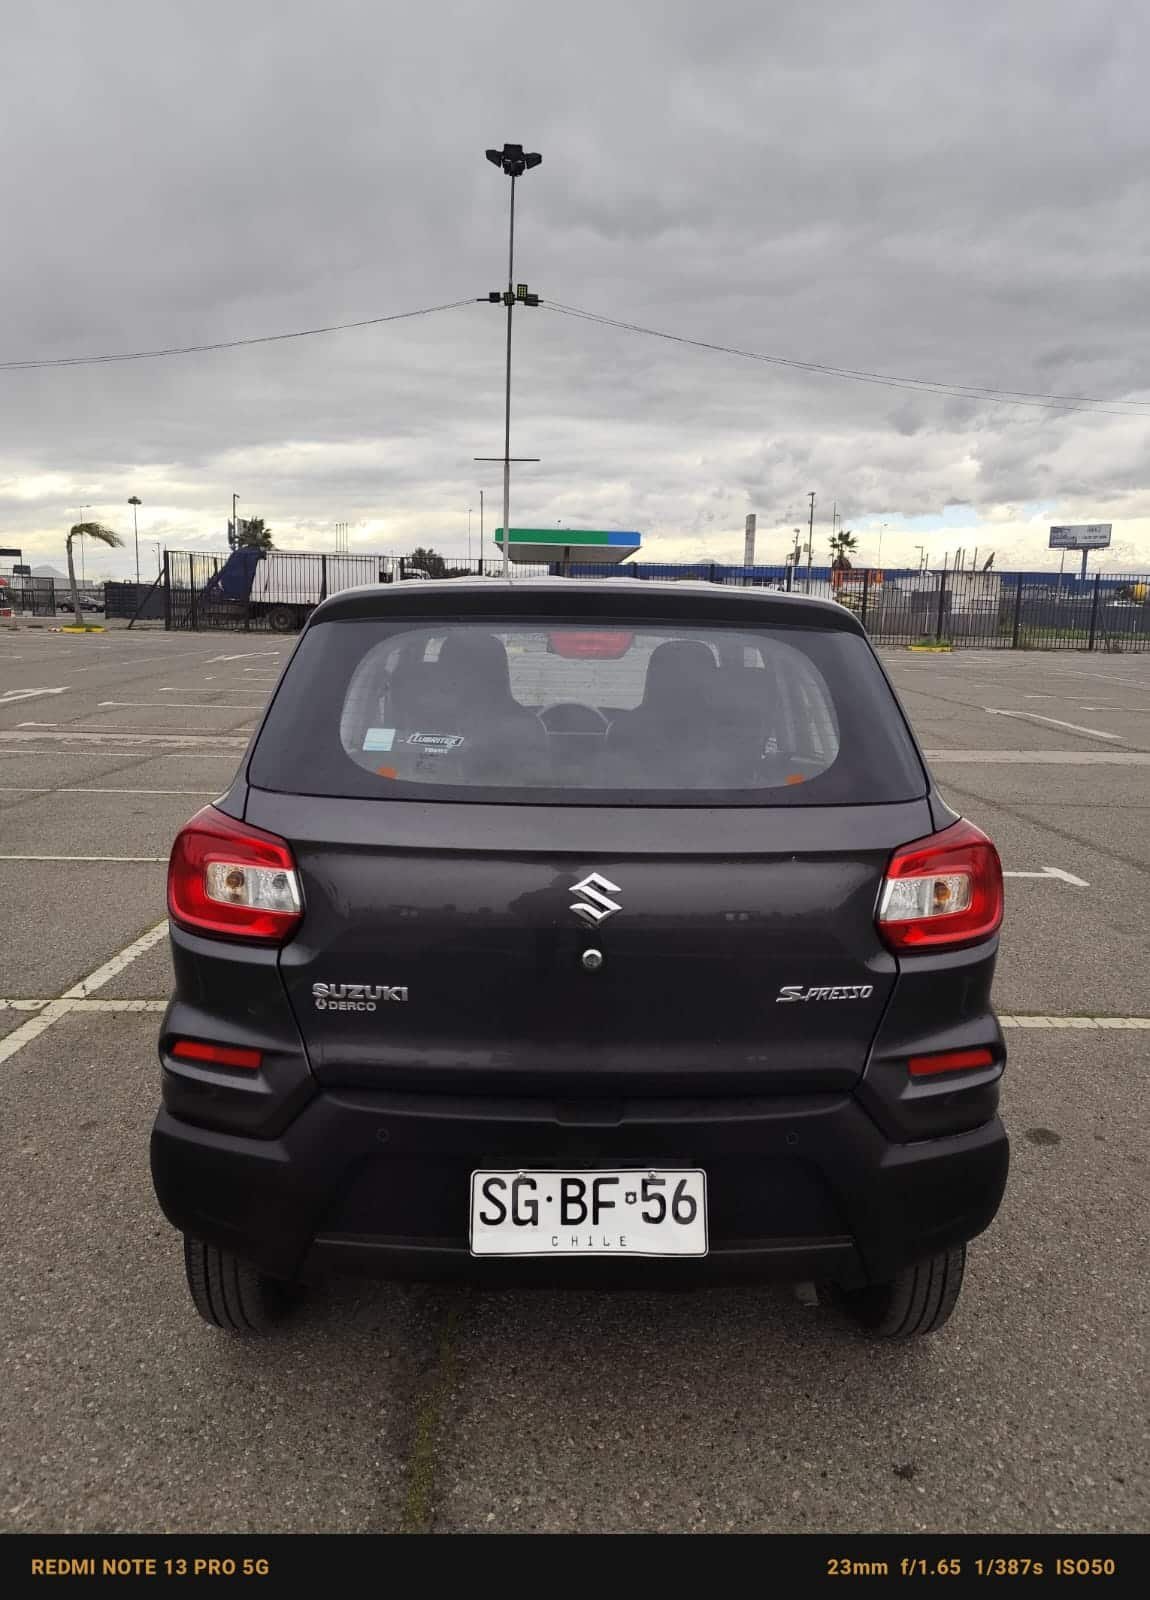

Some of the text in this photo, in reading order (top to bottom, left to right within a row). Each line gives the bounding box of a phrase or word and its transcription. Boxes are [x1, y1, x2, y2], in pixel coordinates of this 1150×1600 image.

[312, 982, 408, 1001] SUZUKI
[328, 1001, 377, 1011] DERCO
[551, 1235, 628, 1247] CHILE
